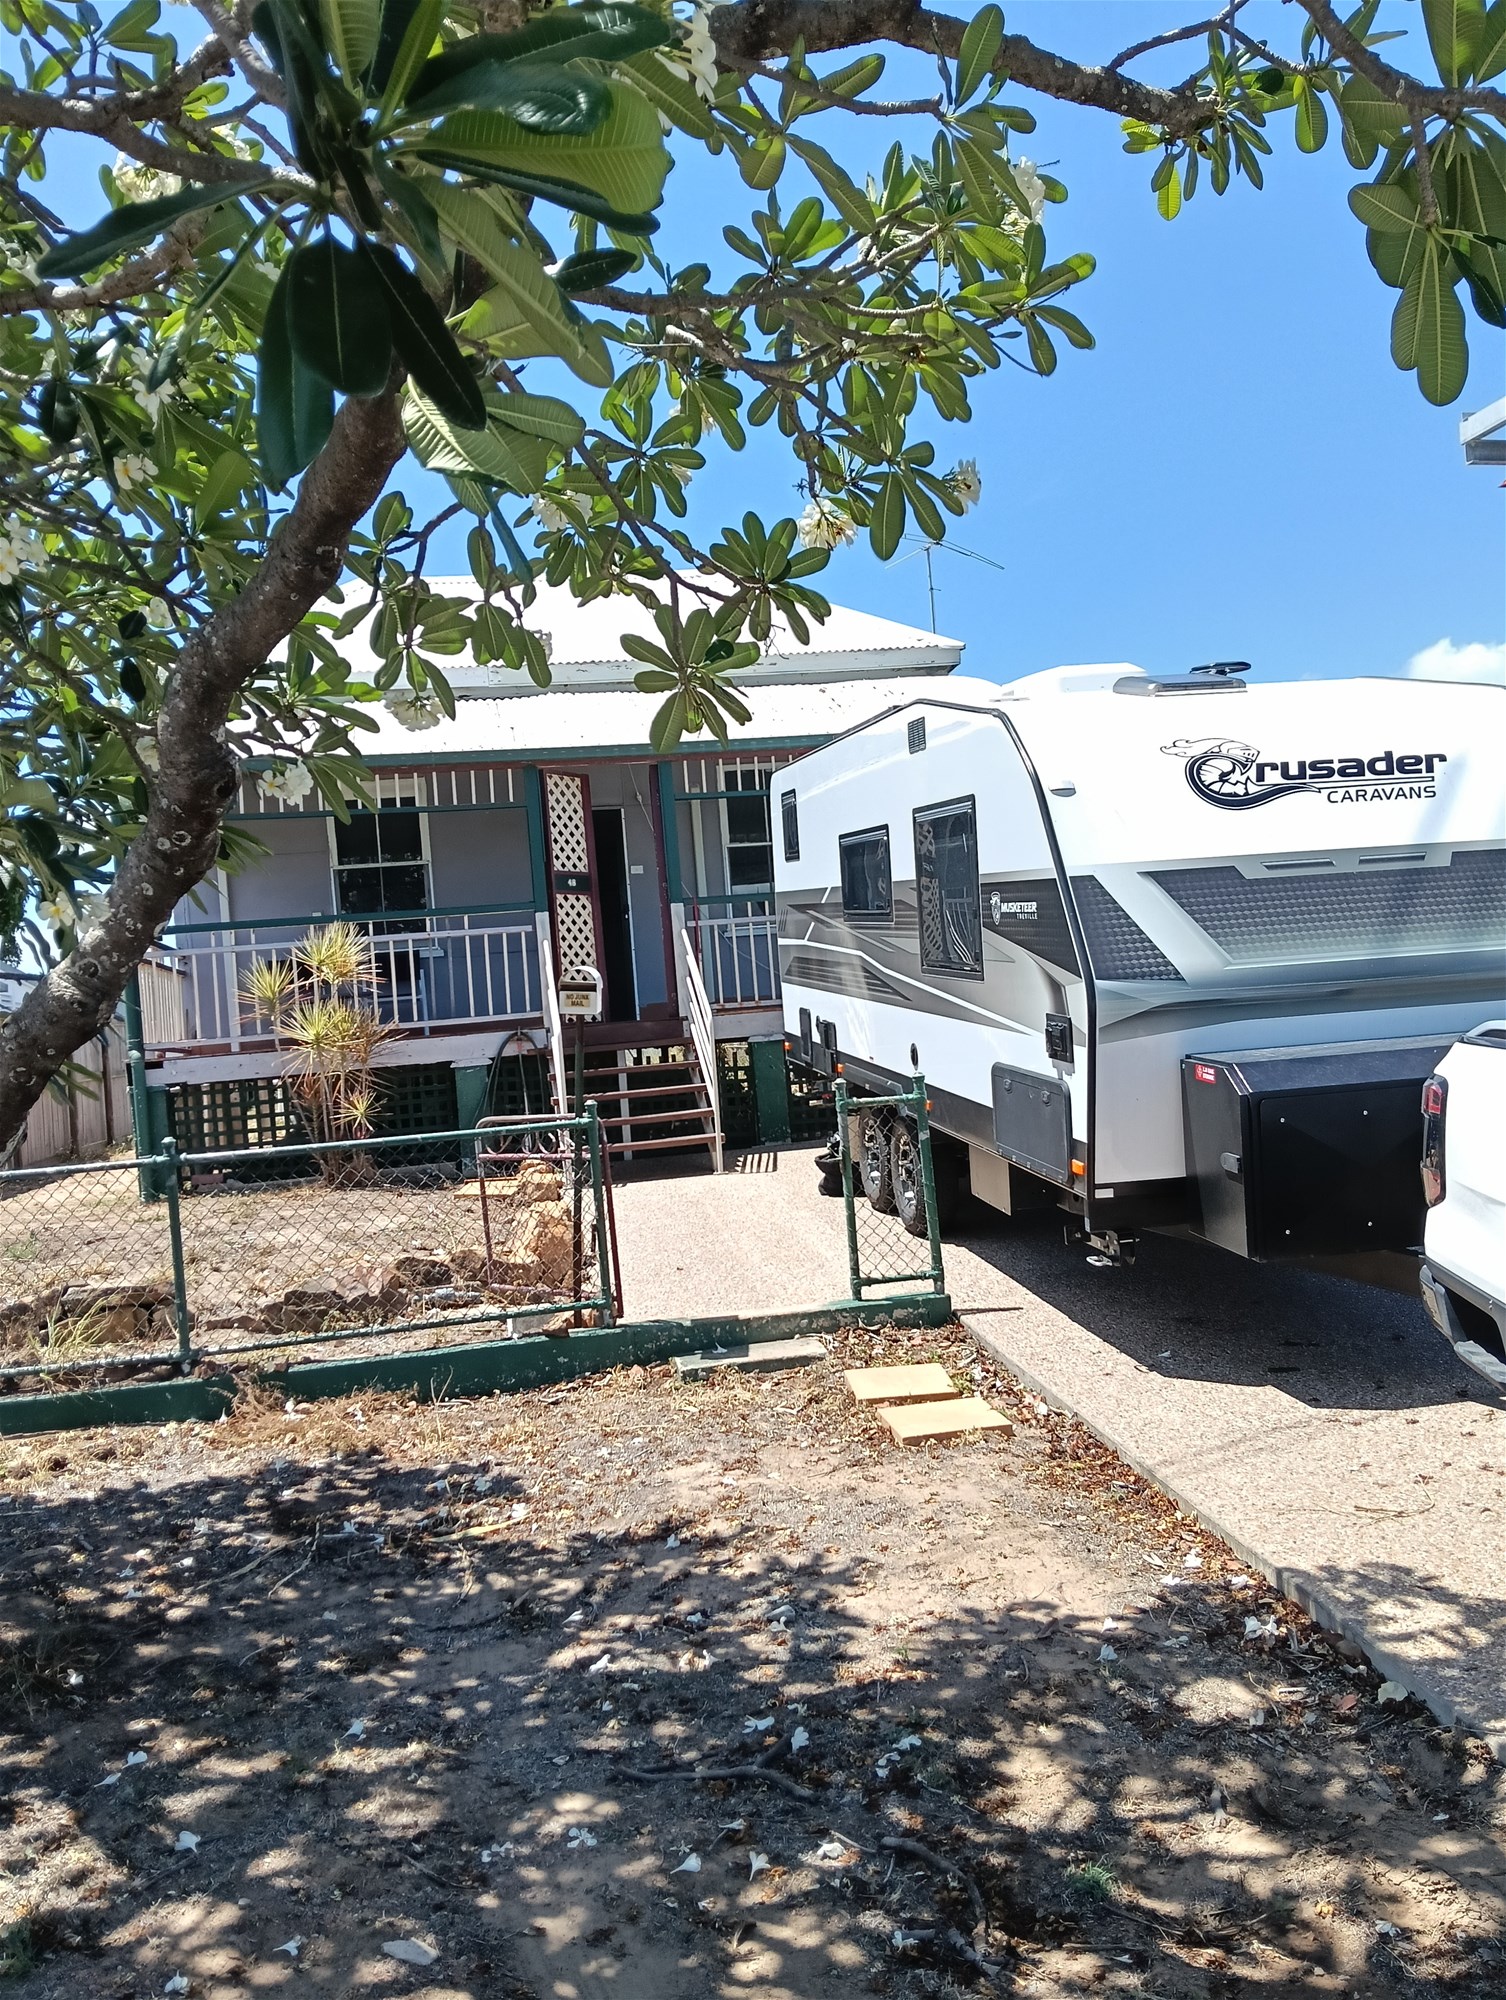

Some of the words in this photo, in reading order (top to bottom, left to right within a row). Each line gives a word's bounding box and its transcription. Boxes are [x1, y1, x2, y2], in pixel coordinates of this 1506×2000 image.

[1185, 750, 1447, 811] Crusader
[1326, 785, 1437, 804] CARAVANS
[1001, 901, 1038, 913] MUSKETEER
